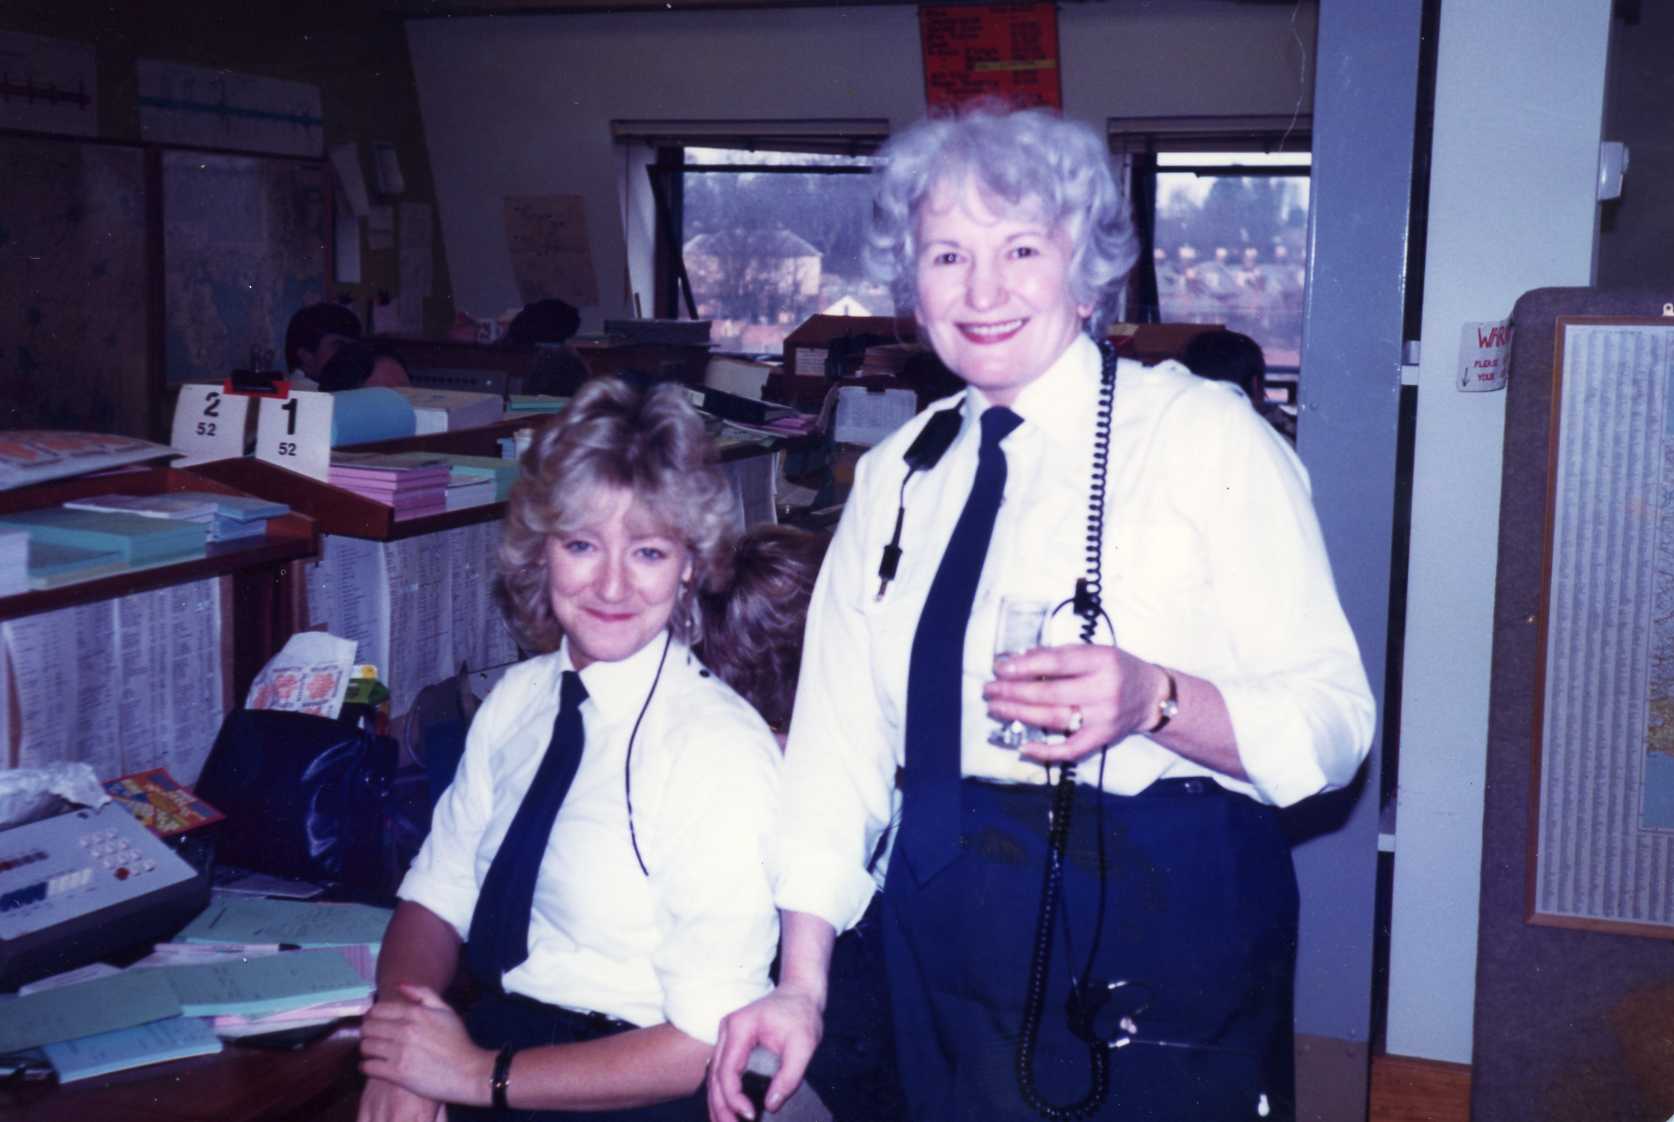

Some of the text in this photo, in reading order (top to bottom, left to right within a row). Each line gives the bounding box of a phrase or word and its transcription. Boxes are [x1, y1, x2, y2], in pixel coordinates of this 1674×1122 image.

[203, 392, 221, 417] 2
[281, 398, 298, 435] 1
[196, 422, 216, 437] 52
[278, 442, 297, 456] 52
